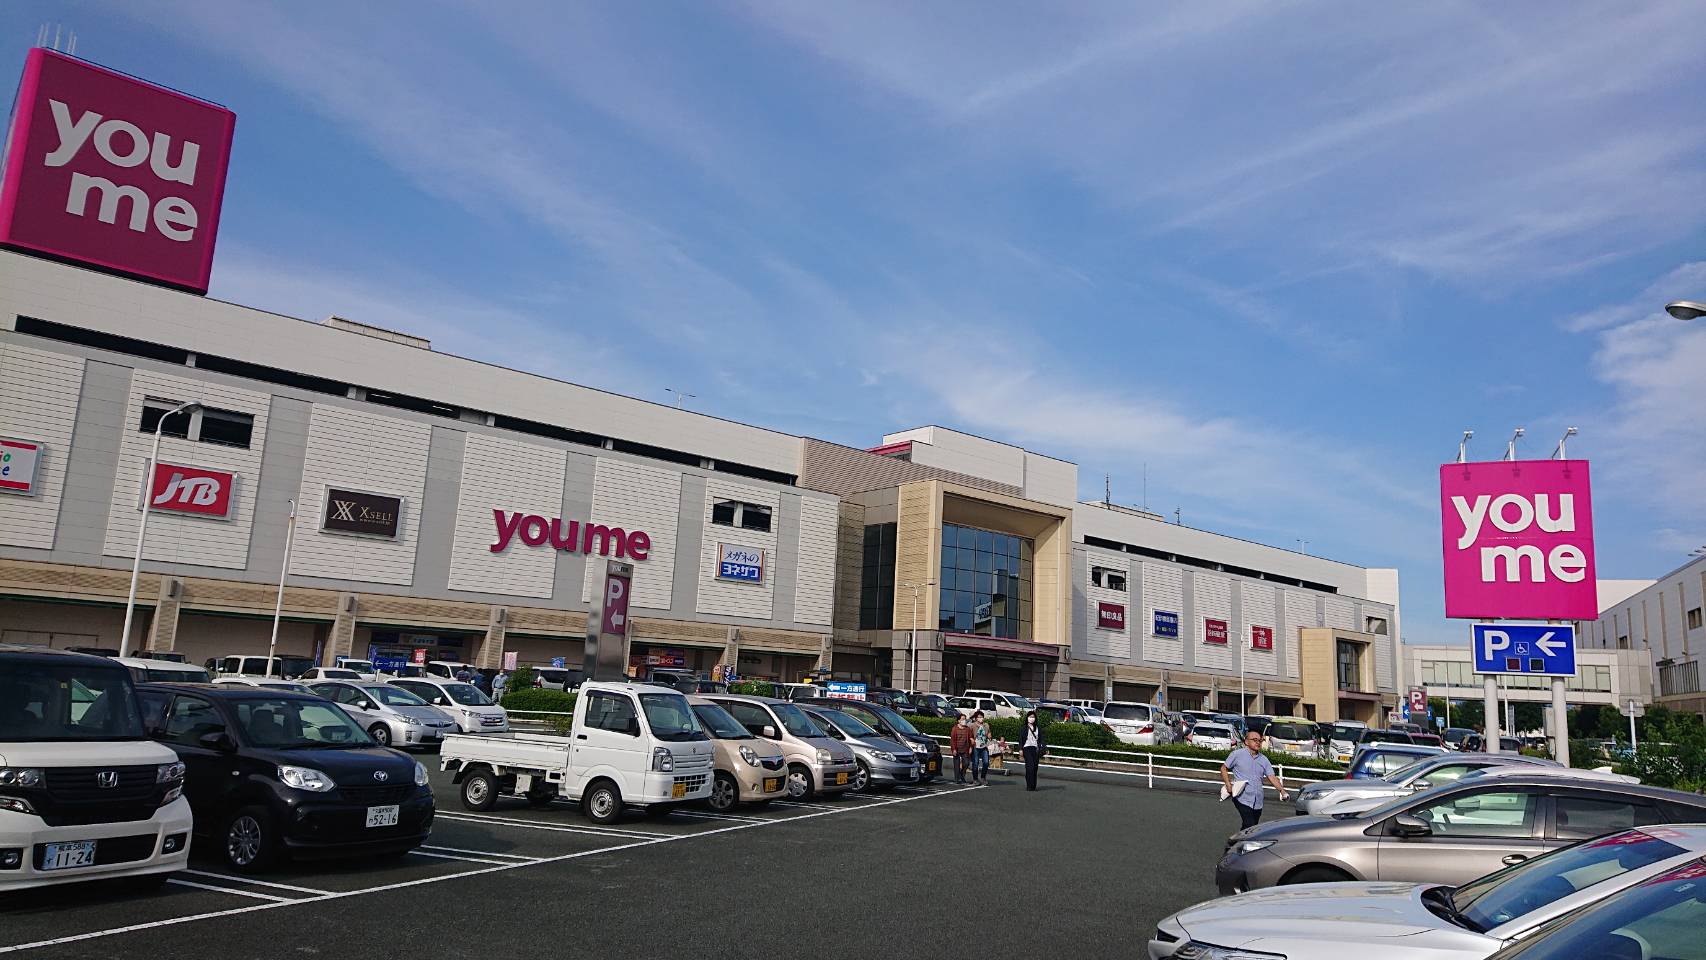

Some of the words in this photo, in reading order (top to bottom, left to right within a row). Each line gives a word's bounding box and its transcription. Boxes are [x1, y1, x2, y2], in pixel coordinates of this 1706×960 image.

[44, 98, 200, 186] you
[65, 171, 198, 242] me
[153, 472, 220, 506] JTB
[1451, 493, 1575, 550] you
[724, 550, 760, 563] メガネの
[1480, 544, 1587, 583] me
[607, 578, 624, 607] P
[1483, 630, 1510, 661] P
[1411, 691, 1423, 704] P
[56, 851, 93, 867] 11-24
